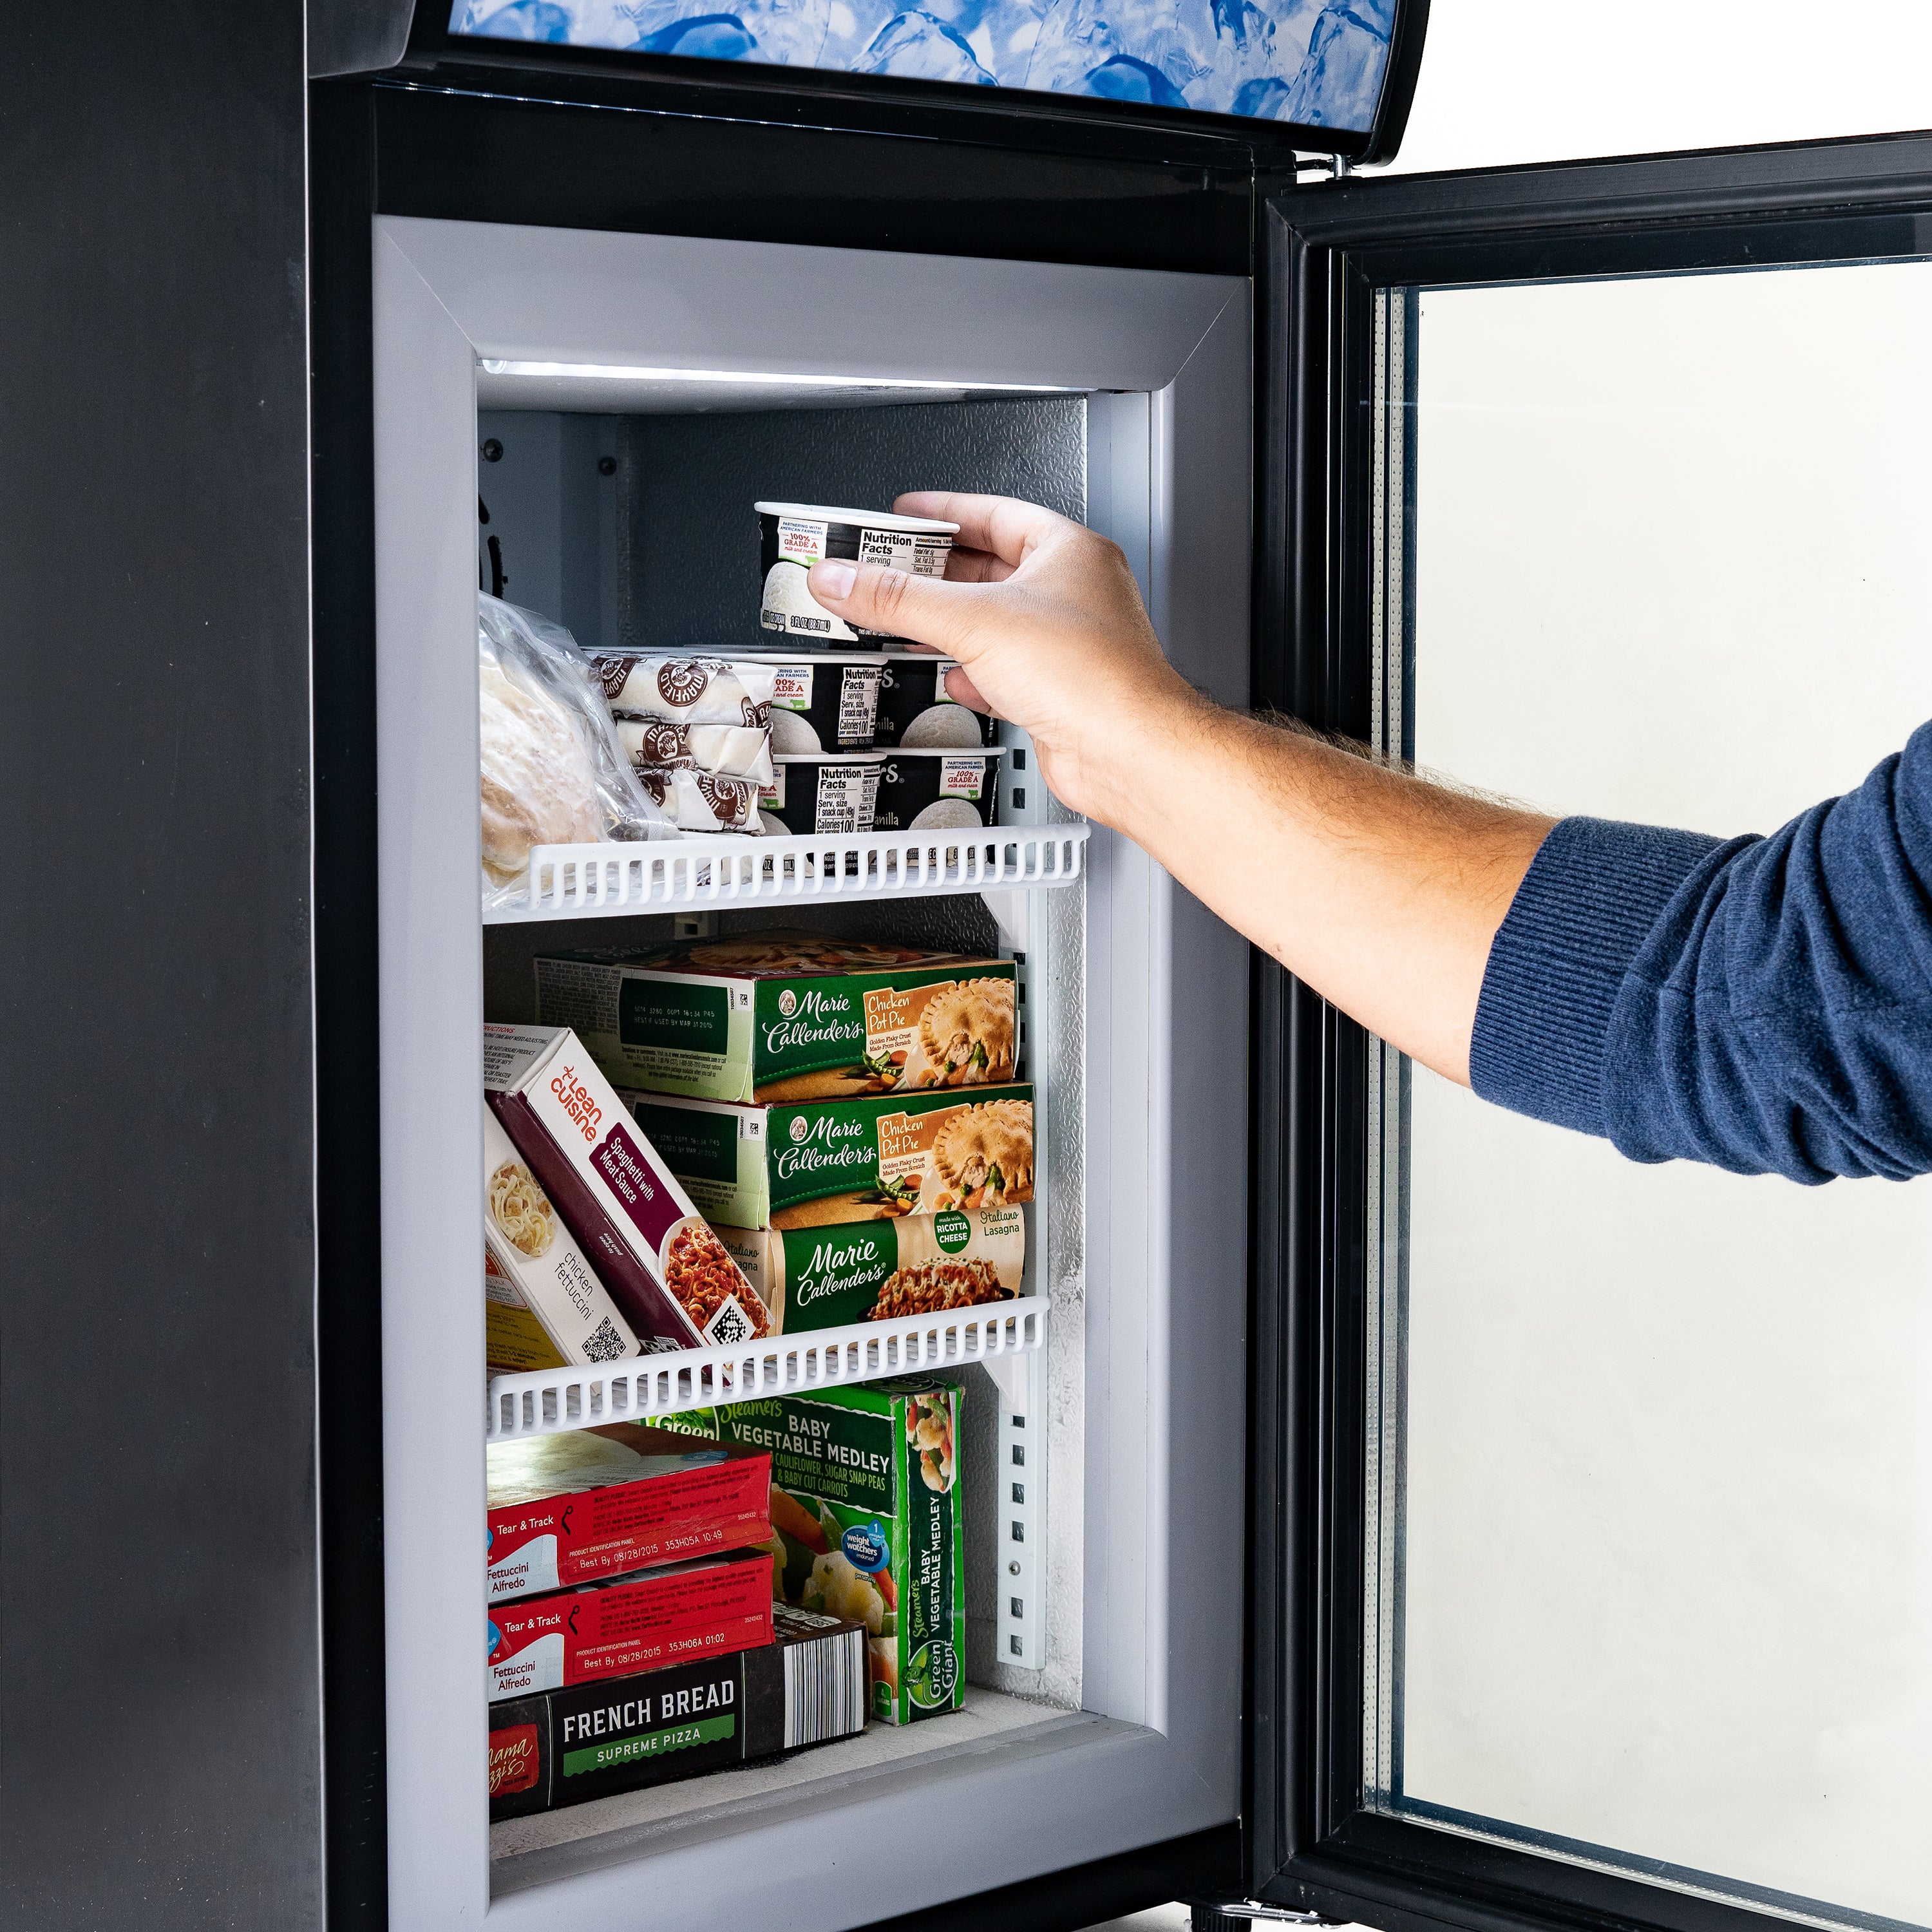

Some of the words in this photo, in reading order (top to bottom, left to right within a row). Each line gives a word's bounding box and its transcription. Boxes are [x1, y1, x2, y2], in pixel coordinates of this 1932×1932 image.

[784, 539, 809, 547] GRADE
[790, 533, 810, 542] 100%
[864, 533, 912, 546] Nutrition
[862, 543, 893, 555] Facts
[866, 556, 891, 567] serving
[795, 617, 800, 627] FL
[800, 618, 807, 628] OZ
[845, 669, 876, 679] Nutrition
[661, 672, 704, 703] MAYFIELD
[844, 680, 864, 690] Facts
[841, 700, 855, 708] Serv.
[847, 692, 864, 701] serving
[840, 721, 858, 730] Calories
[858, 721, 868, 734] 100
[821, 768, 861, 779] Nutrition
[820, 780, 846, 789] Facts
[825, 791, 845, 800] serving
[817, 820, 840, 829] Calories
[840, 820, 854, 833] 100
[782, 990, 850, 1023] Marie
[868, 993, 909, 1012] Chicken
[870, 1014, 887, 1033] Pot
[889, 1011, 905, 1028] Pie
[762, 1019, 864, 1054] Callender's
[886, 1036, 898, 1044] Flaky
[793, 1116, 863, 1148] Marie
[882, 1117, 923, 1137] Chicken
[883, 1139, 900, 1157] Pot
[902, 1135, 918, 1153] Pie
[611, 1137, 645, 1184] Spaghetti
[639, 1179, 654, 1201] with
[773, 1144, 876, 1179] Callender's
[899, 1160, 912, 1168] Flaky
[909, 1163, 925, 1171] Scratch
[600, 1149, 620, 1178] Meat
[615, 1173, 637, 1204] Sauce
[980, 1209, 1019, 1224] Italiano
[936, 1222, 968, 1233] RICOTTA
[984, 1225, 1019, 1236] Lasagna
[600, 1236, 610, 1248] open
[604, 1233, 614, 1244] here
[939, 1233, 967, 1244] CHEESE
[611, 1244, 623, 1255] push
[798, 1238, 878, 1280] Marie
[564, 1251, 593, 1297] chicken
[554, 1262, 593, 1321] fettuccini
[797, 1264, 884, 1306] Callender's
[789, 1414, 830, 1439] BABY
[732, 1422, 824, 1459] VEGETABLE
[828, 1443, 889, 1473] MEDLEY
[775, 1453, 824, 1477] CAULIFLOWER,
[825, 1464, 847, 1480] SUGAR
[849, 1470, 867, 1486] SNAP
[868, 1474, 885, 1491] PEAS
[777, 1471, 783, 1482] &
[784, 1472, 802, 1487] BABY
[804, 1476, 816, 1489] CUT
[818, 1479, 848, 1497] CARROTS
[497, 1524, 516, 1535] Tear
[520, 1520, 527, 1530] &
[529, 1515, 554, 1528] Track
[874, 1524, 878, 1533] 1
[931, 1497, 941, 1549] MEDLEY
[847, 1535, 869, 1546] weight
[569, 1548, 589, 1557] PRODUCT
[589, 1542, 620, 1553] IDENTIFICATION
[580, 1555, 598, 1569] Best
[601, 1555, 611, 1566] By
[614, 1542, 658, 1562] 08/28/2015
[665, 1537, 700, 1551] 353H05A
[703, 1530, 723, 1542] 10:49
[847, 1542, 877, 1556] watchers
[857, 1553, 874, 1562] endorsed
[488, 1562, 528, 1580] Fettuccini
[921, 1549, 931, 1584] BABY
[492, 1577, 525, 1593] Alfredo
[931, 1553, 941, 1632] VEGETABLE
[910, 1579, 929, 1638] Steamers
[505, 1620, 524, 1633] Tear
[527, 1618, 535, 1629] &
[536, 1613, 561, 1627] Track
[576, 1649, 596, 1657] PRODUCT
[596, 1643, 627, 1653] IDENTIFICATION
[585, 1658, 601, 1669] Best
[605, 1656, 614, 1666] By
[618, 1647, 661, 1663] 08/28/2015
[668, 1640, 702, 1652] 353H06A
[705, 1633, 724, 1645] 01:02
[494, 1661, 535, 1678] Fettuccini
[929, 1644, 941, 1699] Green
[942, 1640, 953, 1689] Giant
[498, 1676, 531, 1691] Alfredo
[564, 1698, 651, 1742] FRENCH
[661, 1680, 734, 1719] BREAD
[597, 1738, 657, 1762] SUPREME
[663, 1728, 701, 1747] PIZZA
